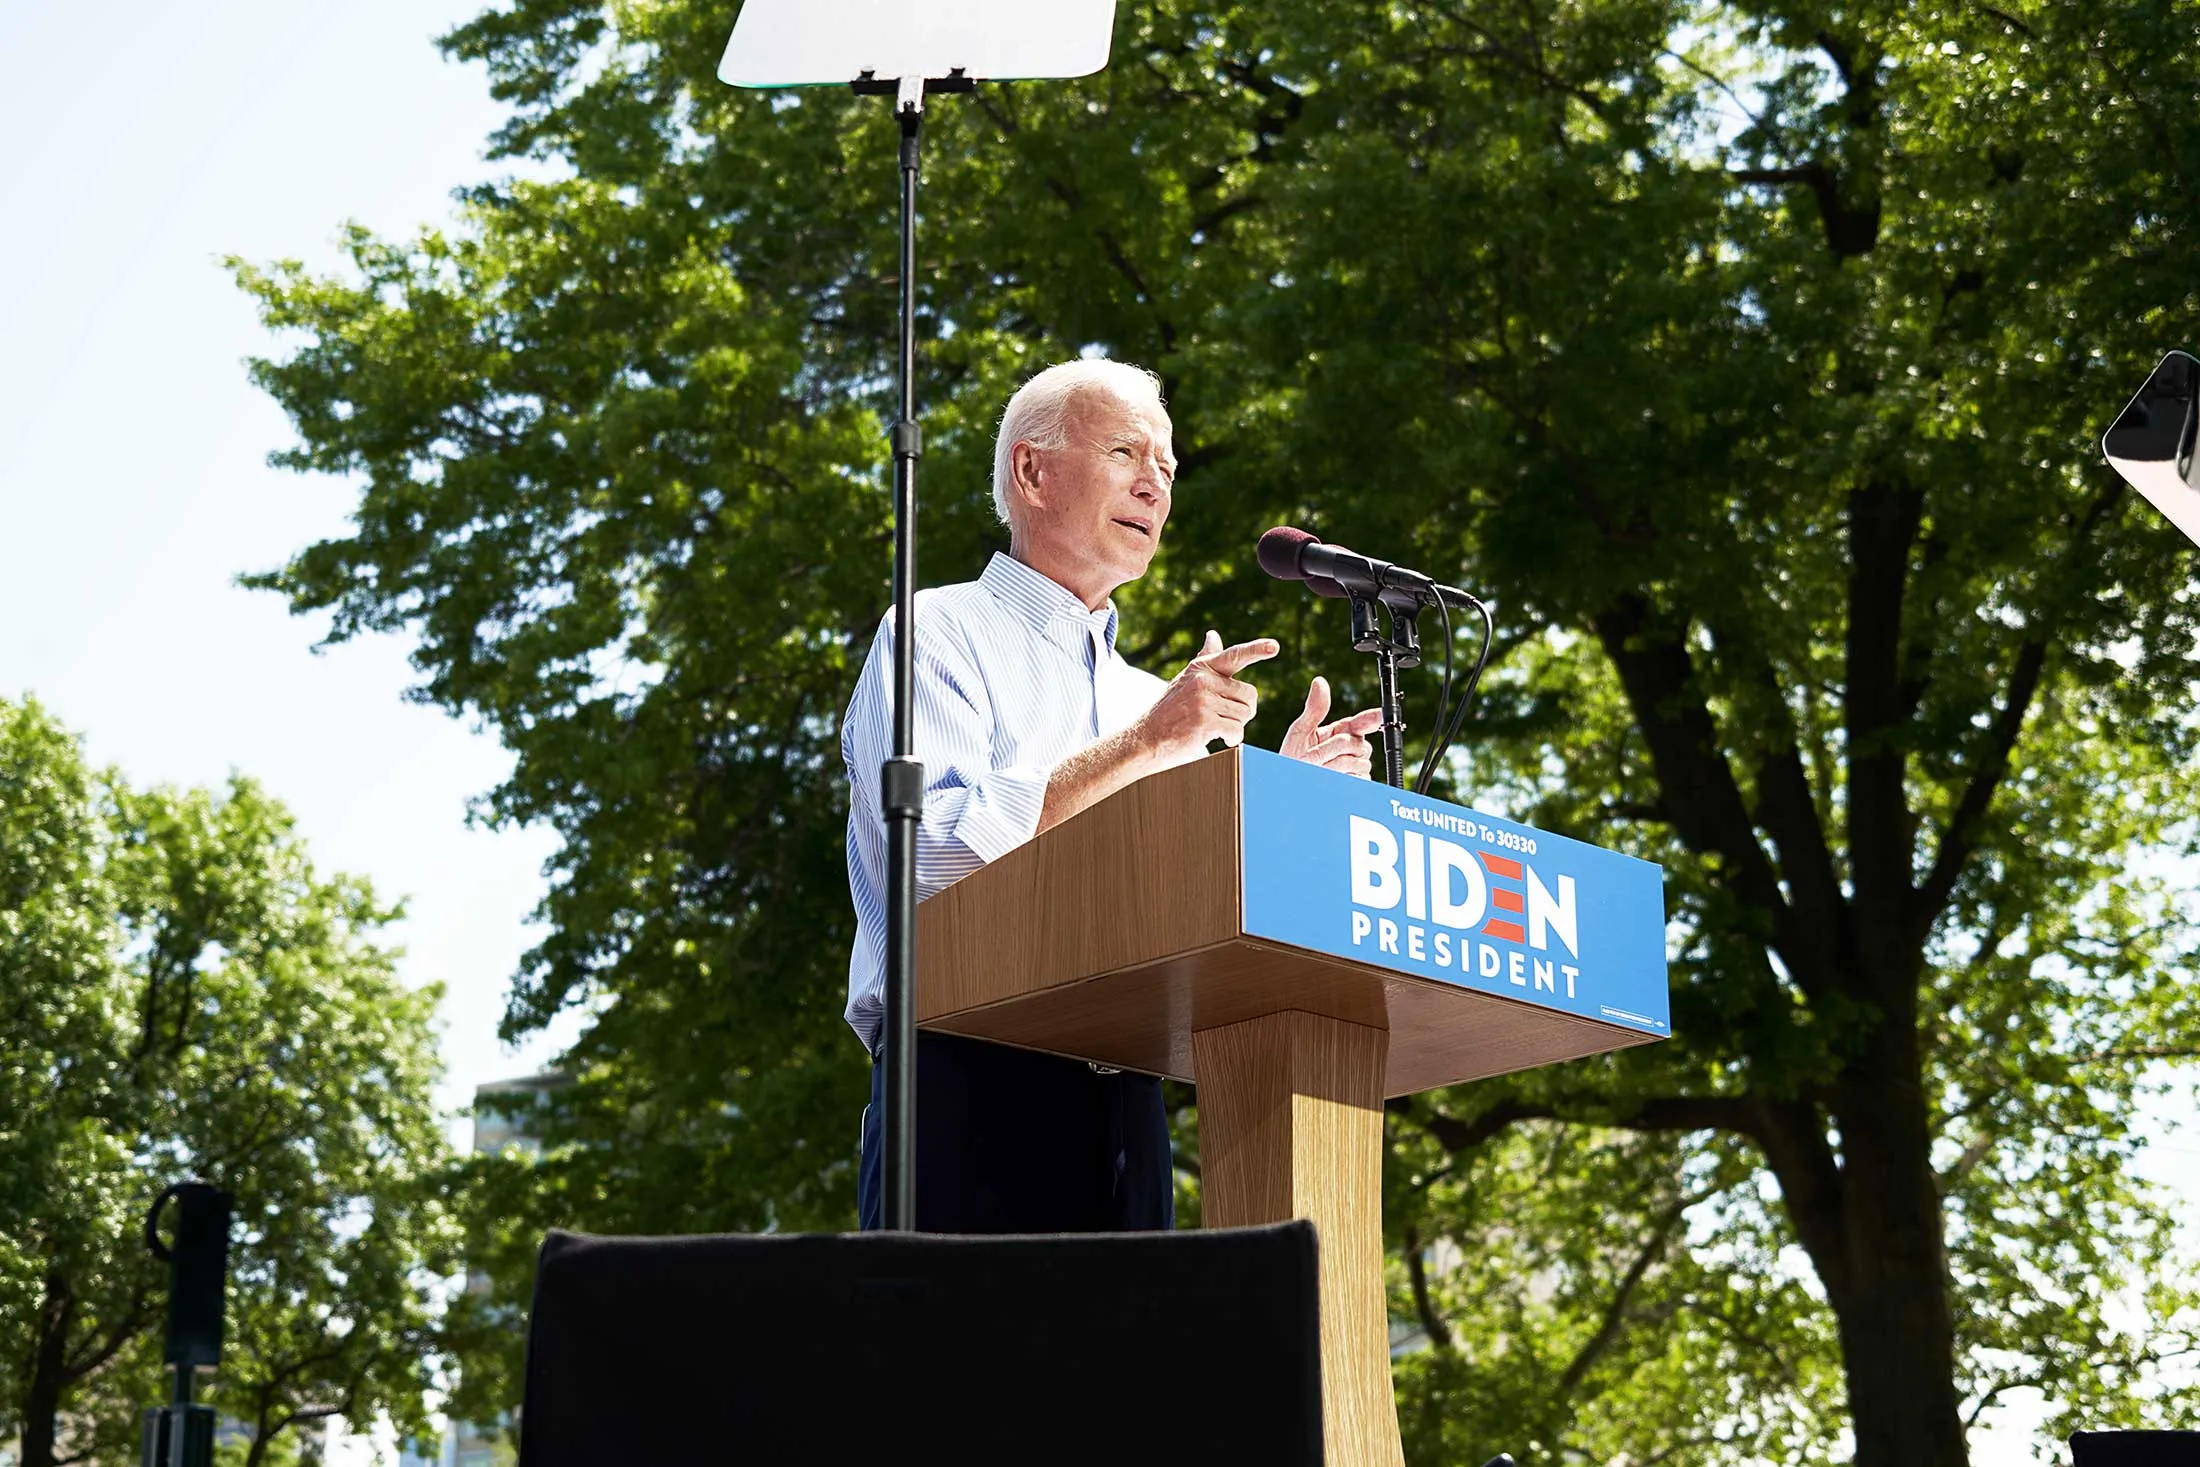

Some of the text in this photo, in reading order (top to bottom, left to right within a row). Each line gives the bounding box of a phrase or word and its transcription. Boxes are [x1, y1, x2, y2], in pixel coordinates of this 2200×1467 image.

[1390, 799, 1537, 856] Text UNITED To 30330
[1349, 815, 1578, 961] BIDEN
[1352, 911, 1579, 999] PRESIDENT
